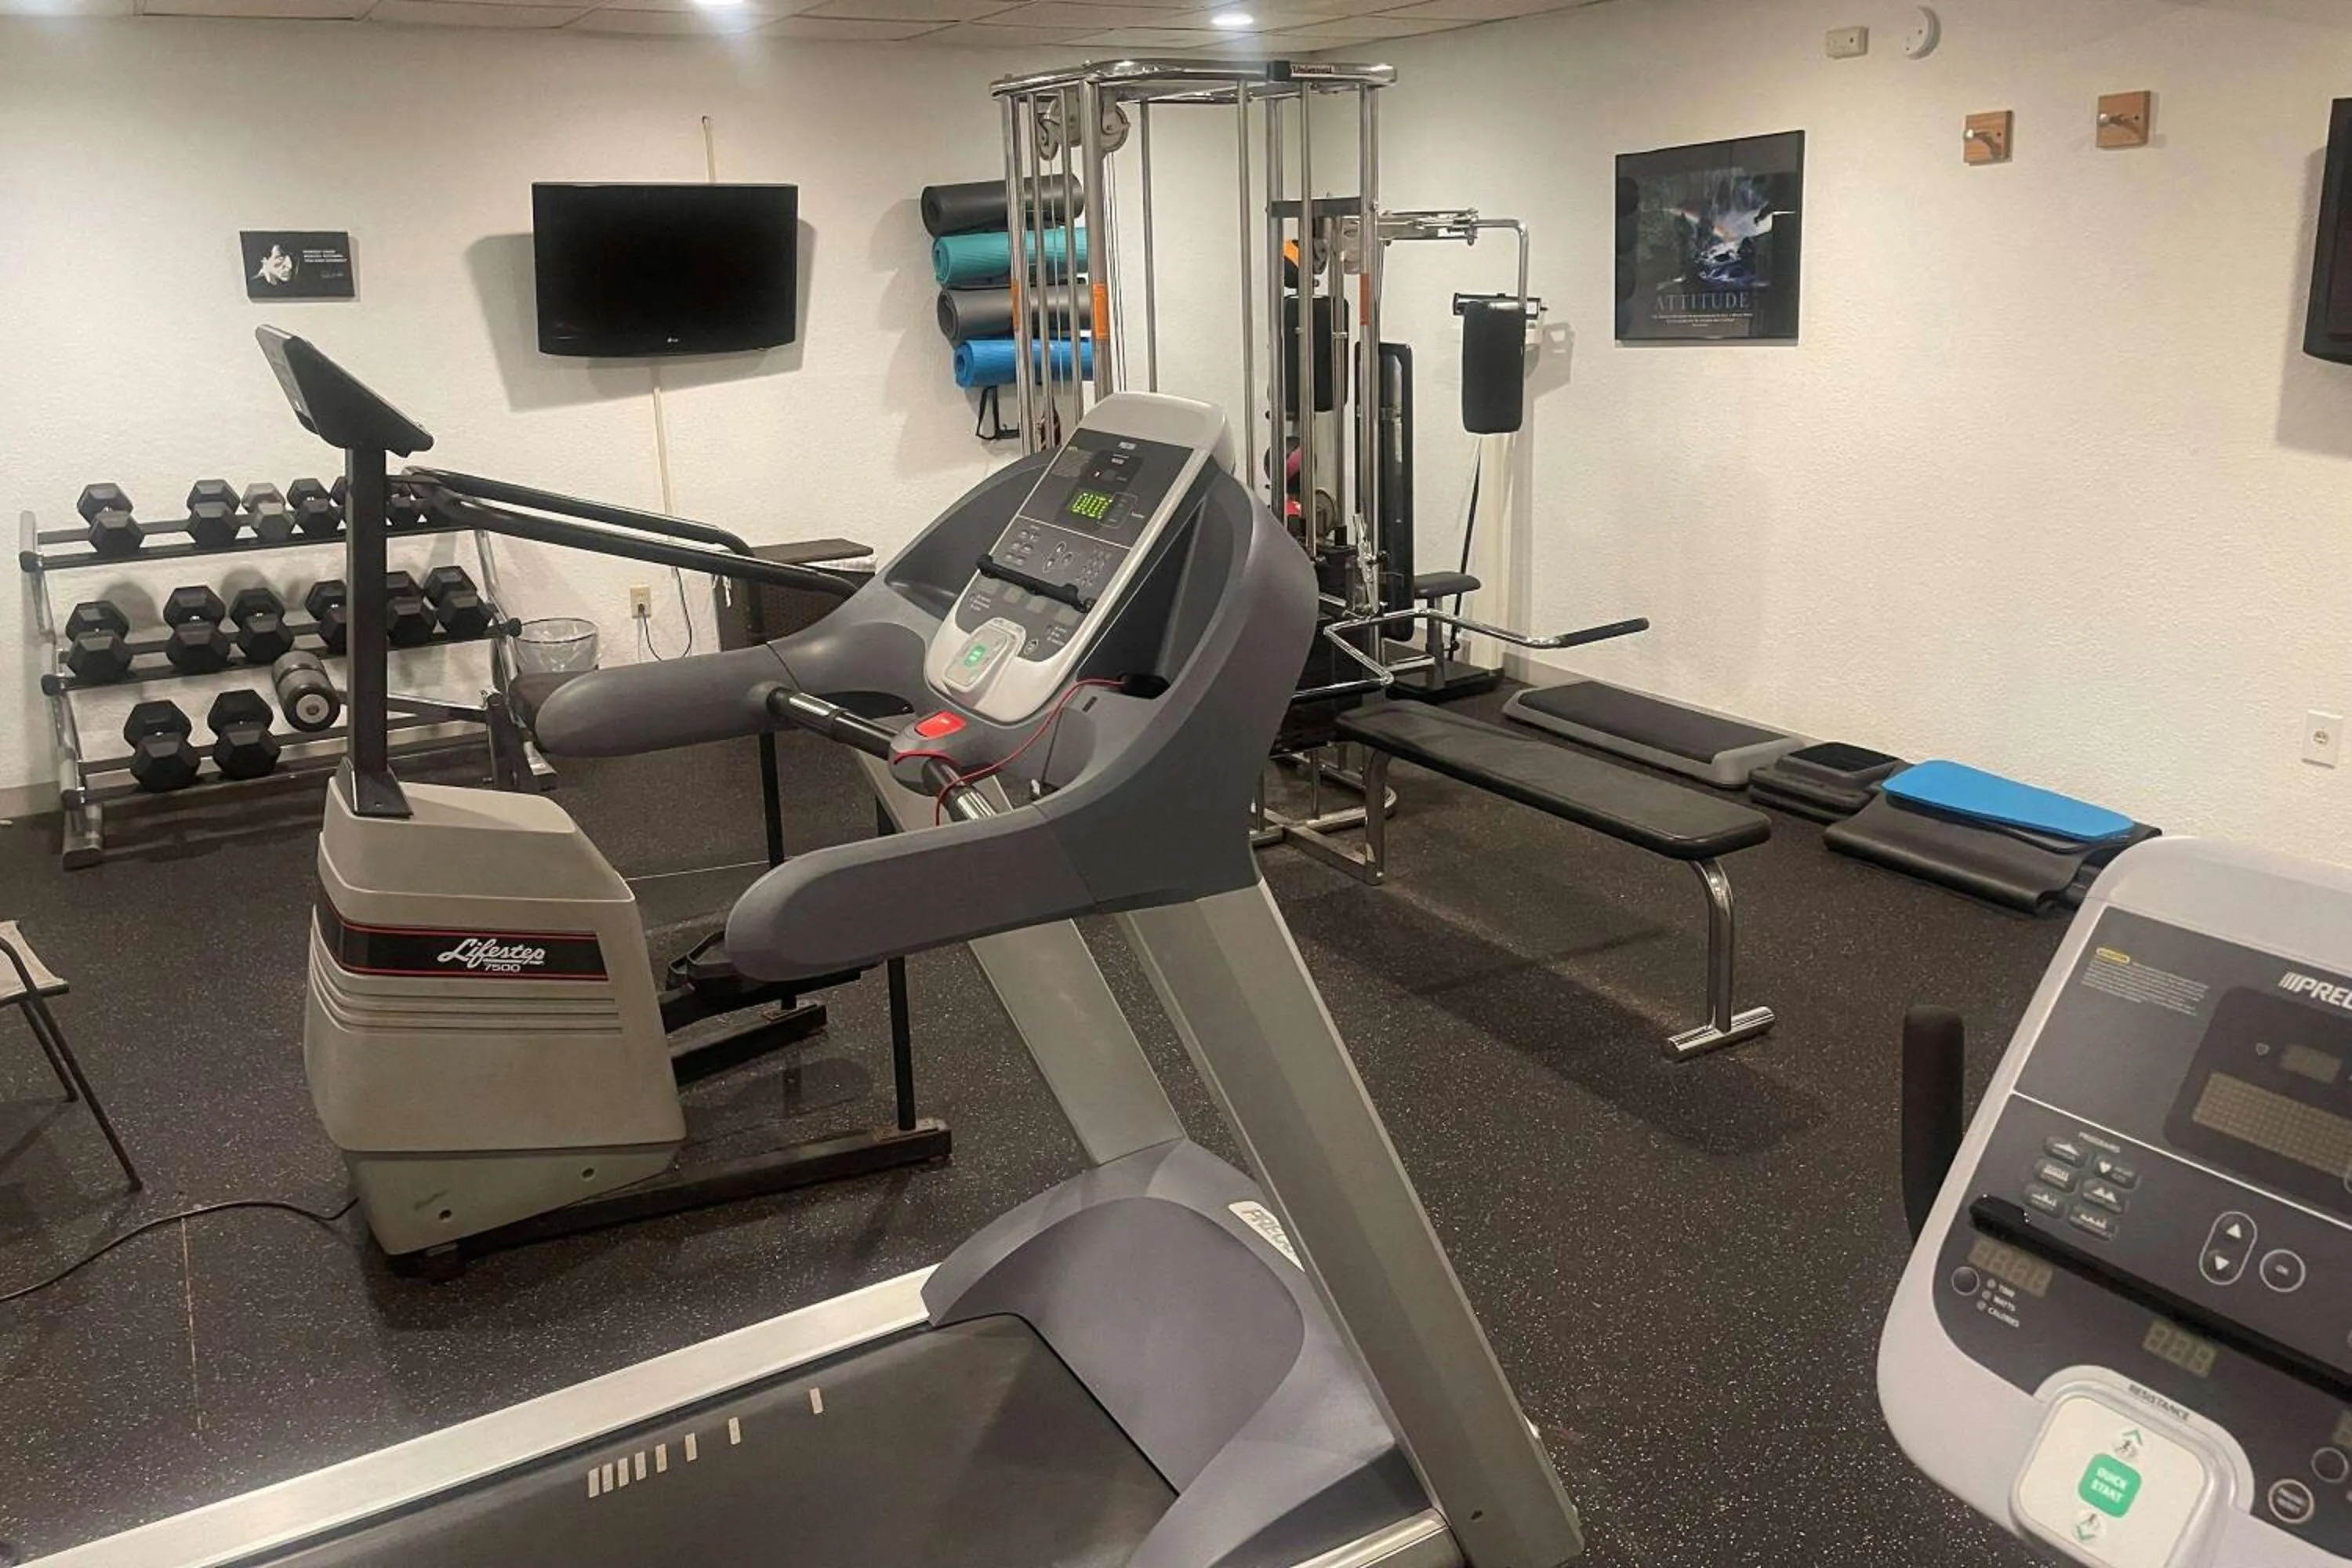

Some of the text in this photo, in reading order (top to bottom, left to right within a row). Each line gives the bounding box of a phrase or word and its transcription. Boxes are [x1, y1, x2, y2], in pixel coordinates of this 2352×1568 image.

[1655, 292, 1751, 311] ATTITUDE
[437, 938, 546, 968] Lifestep
[485, 964, 521, 972] 7500
[2129, 1384, 2190, 1421] RESISTANCE
[2090, 1478, 2123, 1503] START
